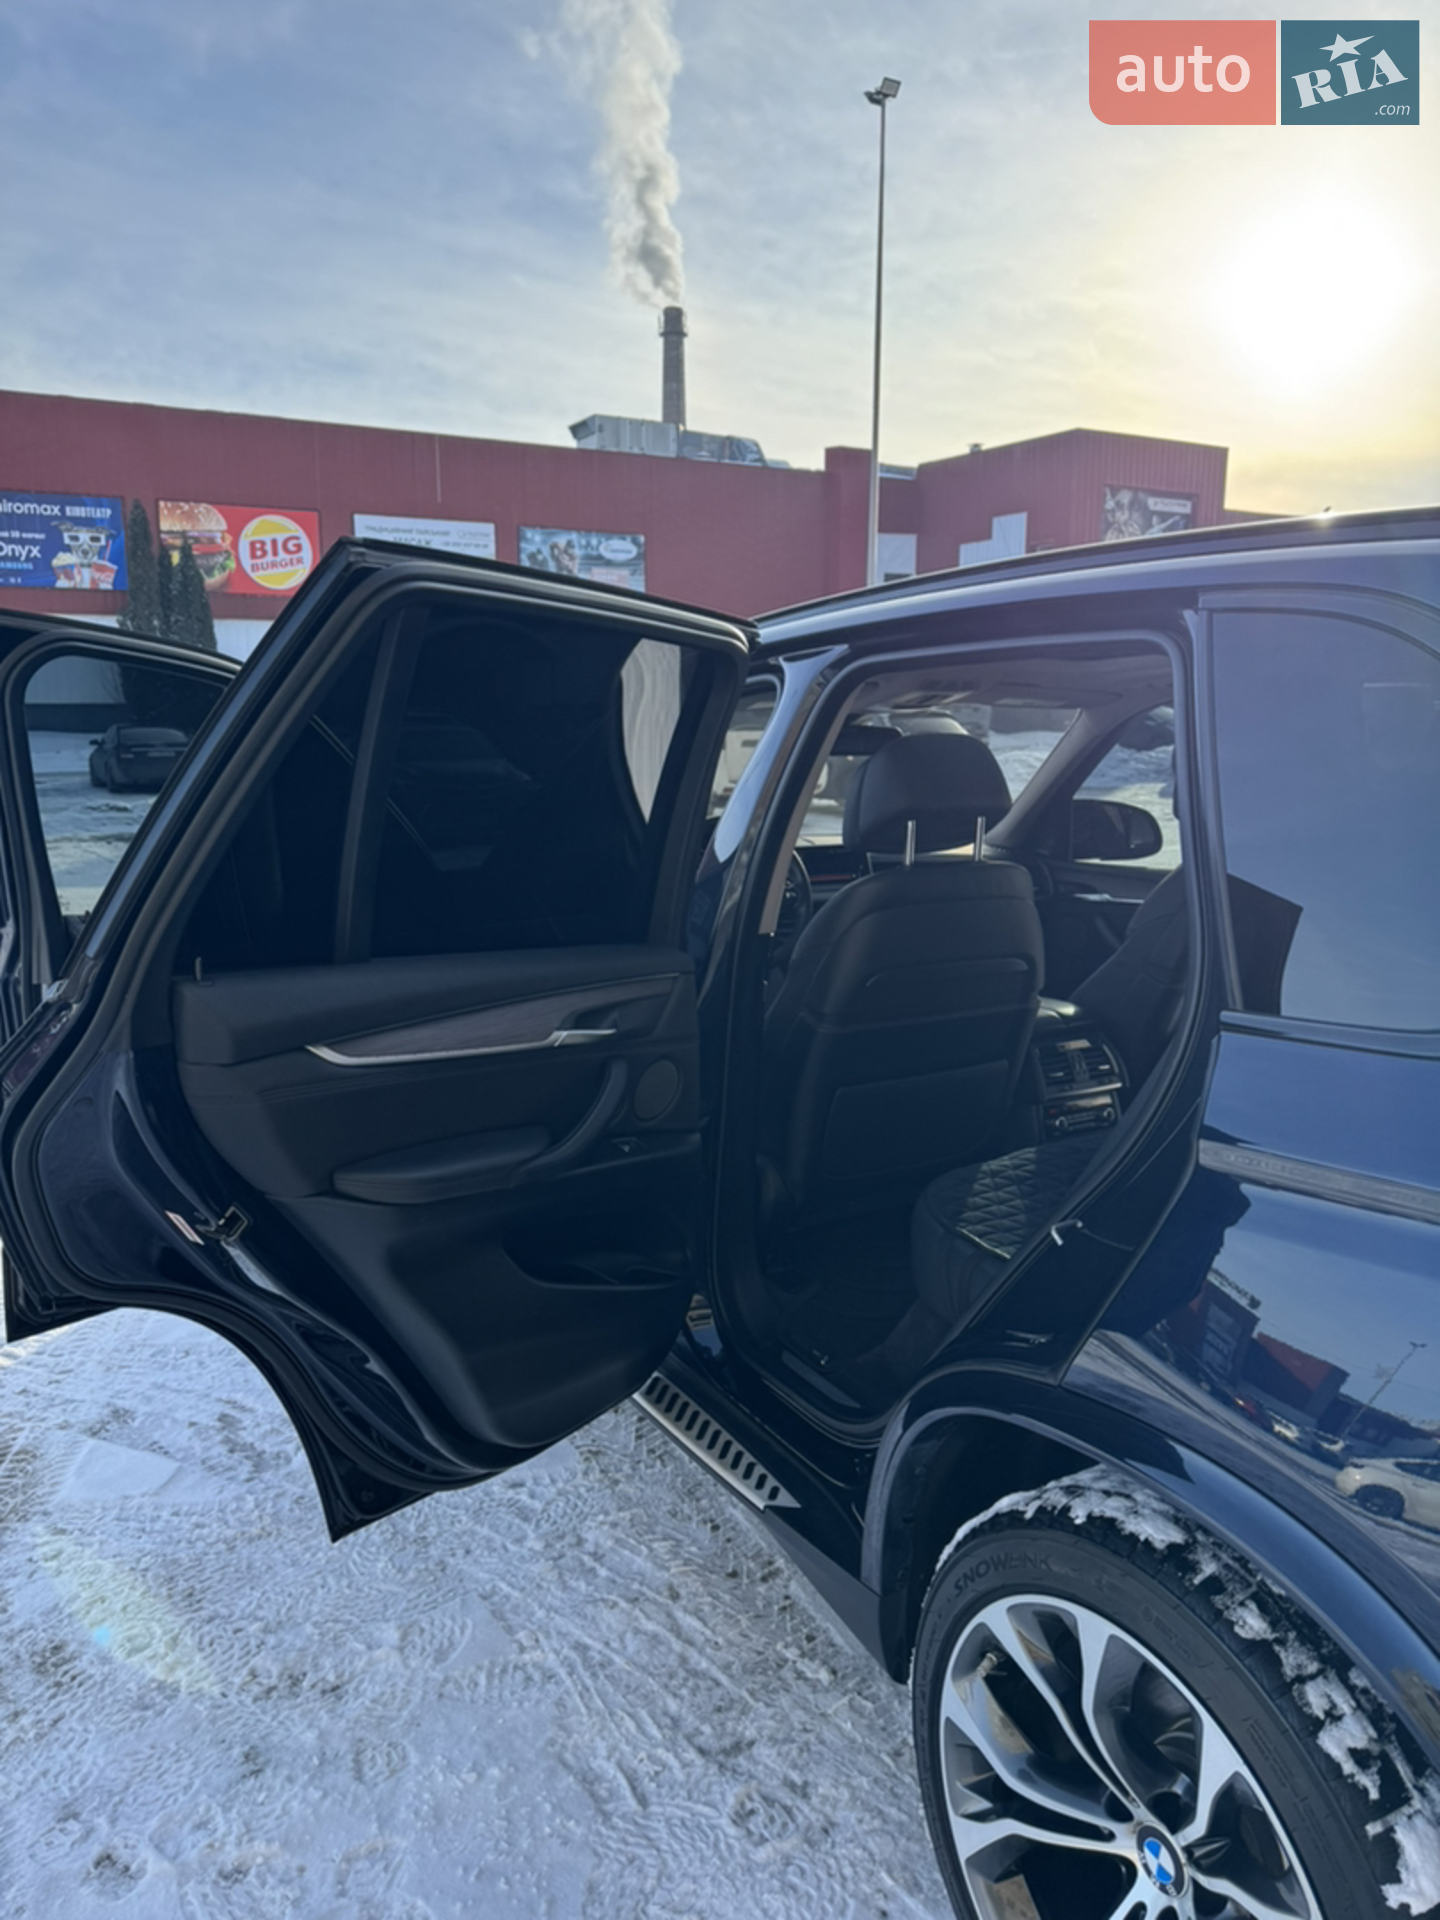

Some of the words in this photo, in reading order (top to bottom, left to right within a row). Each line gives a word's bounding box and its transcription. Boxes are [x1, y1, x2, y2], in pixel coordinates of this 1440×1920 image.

[0, 499, 62, 517] iromax
[249, 535, 303, 560] BIG
[250, 556, 304, 573] BURGER
